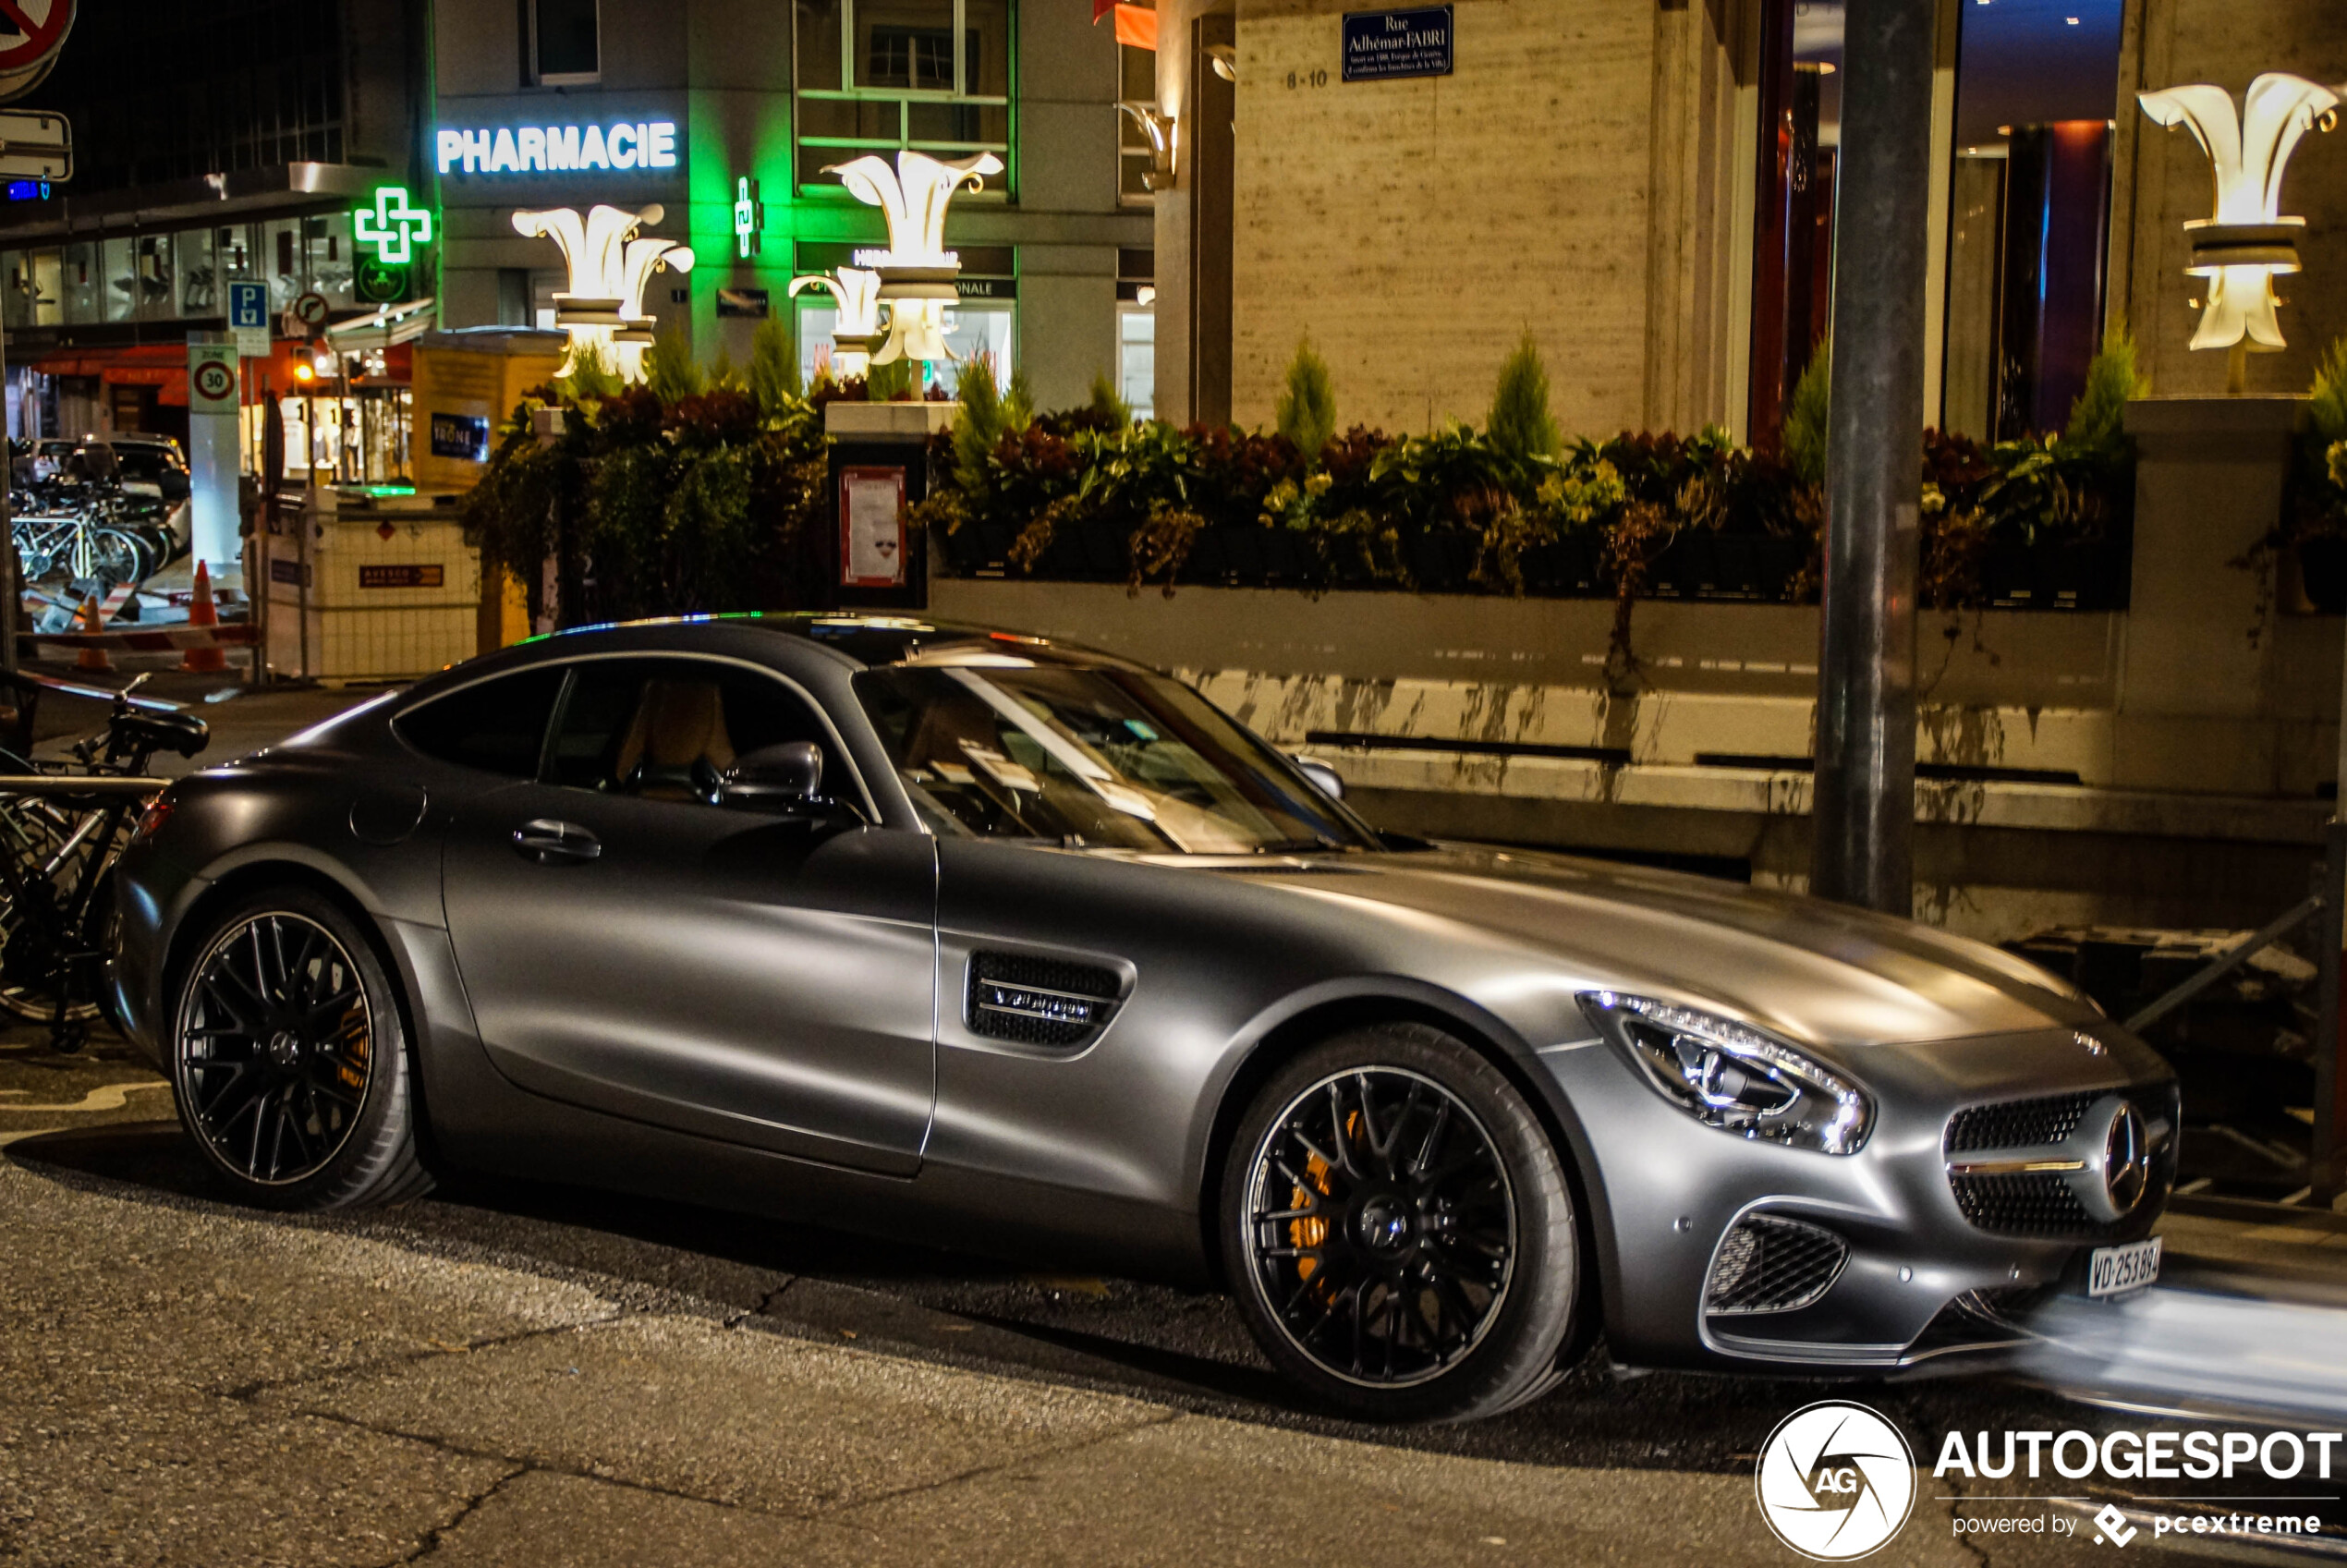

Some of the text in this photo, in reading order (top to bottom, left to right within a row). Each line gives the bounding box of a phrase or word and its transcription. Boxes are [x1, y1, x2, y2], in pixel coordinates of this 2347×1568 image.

[1385, 15, 1409, 32] Rue
[437, 122, 676, 174] PHARMACIE
[242, 286, 256, 307] P
[206, 373, 223, 387] 30
